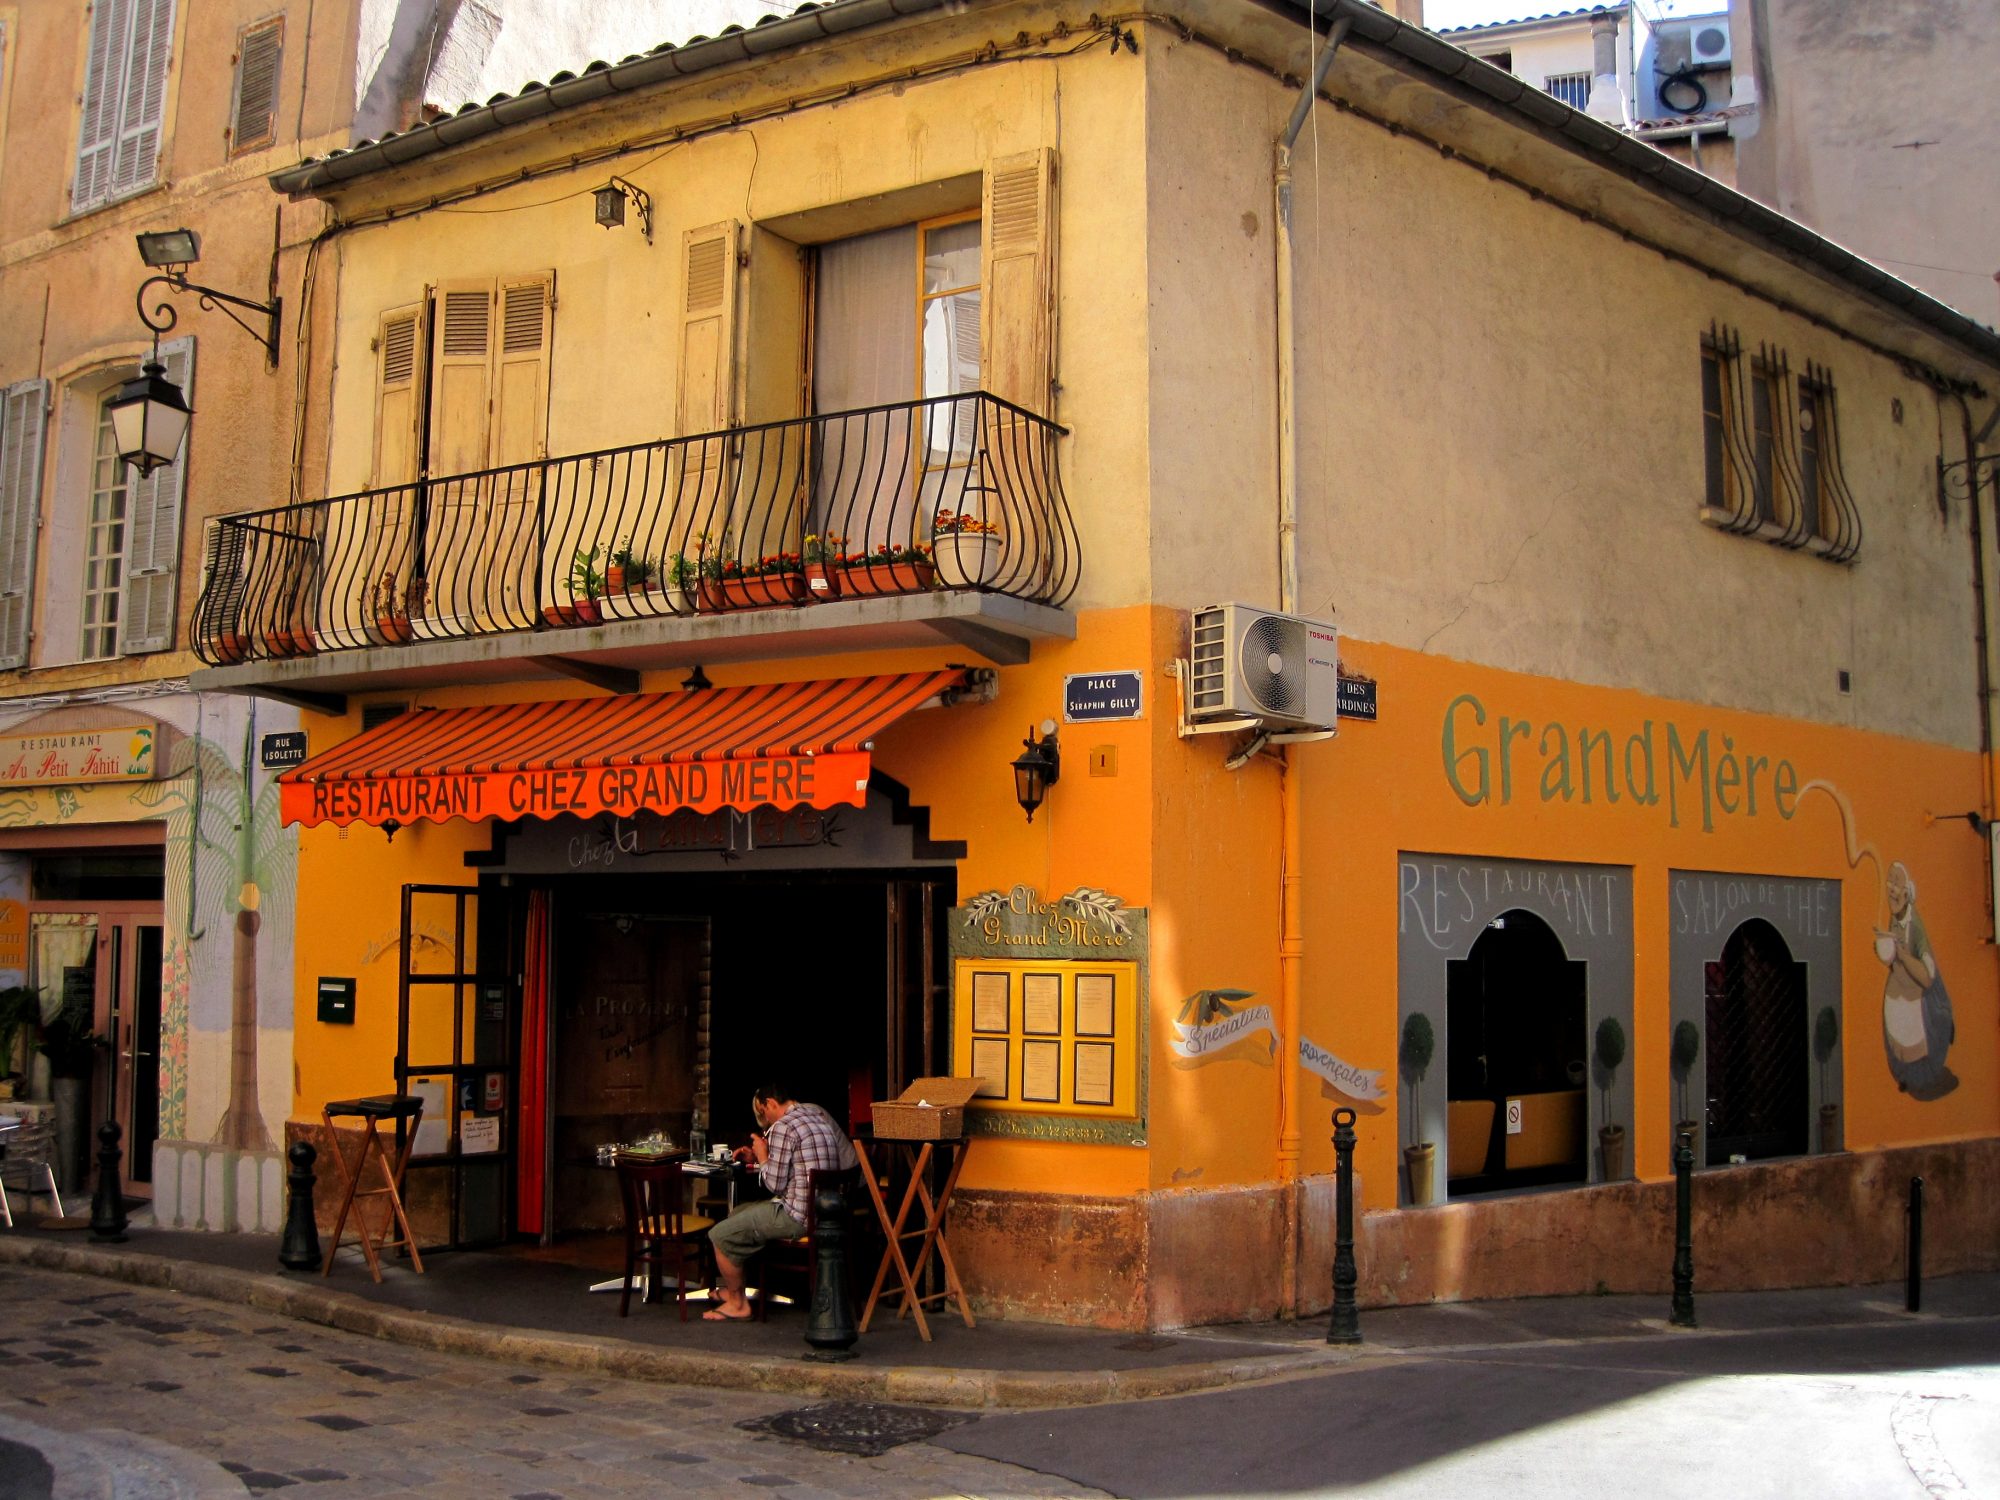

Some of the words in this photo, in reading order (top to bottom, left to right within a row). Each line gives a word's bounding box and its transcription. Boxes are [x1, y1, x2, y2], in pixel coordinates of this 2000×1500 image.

[1309, 631, 1334, 642] TOSHIBA
[1088, 678, 1116, 690] PLACE
[1347, 683, 1365, 695] DES
[1069, 700, 1105, 711] SERAPHIN
[1110, 698, 1136, 709] GILLY
[21, 735, 101, 750] RESTAURANT
[275, 738, 290, 748] RUE
[2, 754, 28, 779] Au
[37, 751, 68, 777] Petit
[80, 748, 119, 776] Tahiti
[265, 749, 303, 760] ISOLETTE
[312, 775, 488, 819] RESTAURANT
[508, 770, 588, 813] CHEZ
[599, 765, 708, 808] GRAND
[720, 757, 816, 802] MERE
[568, 833, 616, 868] Chez
[1010, 886, 1058, 928] Chez
[1400, 863, 1617, 950] RESTAURANT
[1675, 879, 1751, 934] SALON
[1759, 883, 1775, 905] DE
[984, 917, 1048, 945] Grand
[1058, 917, 1126, 946] Mère
